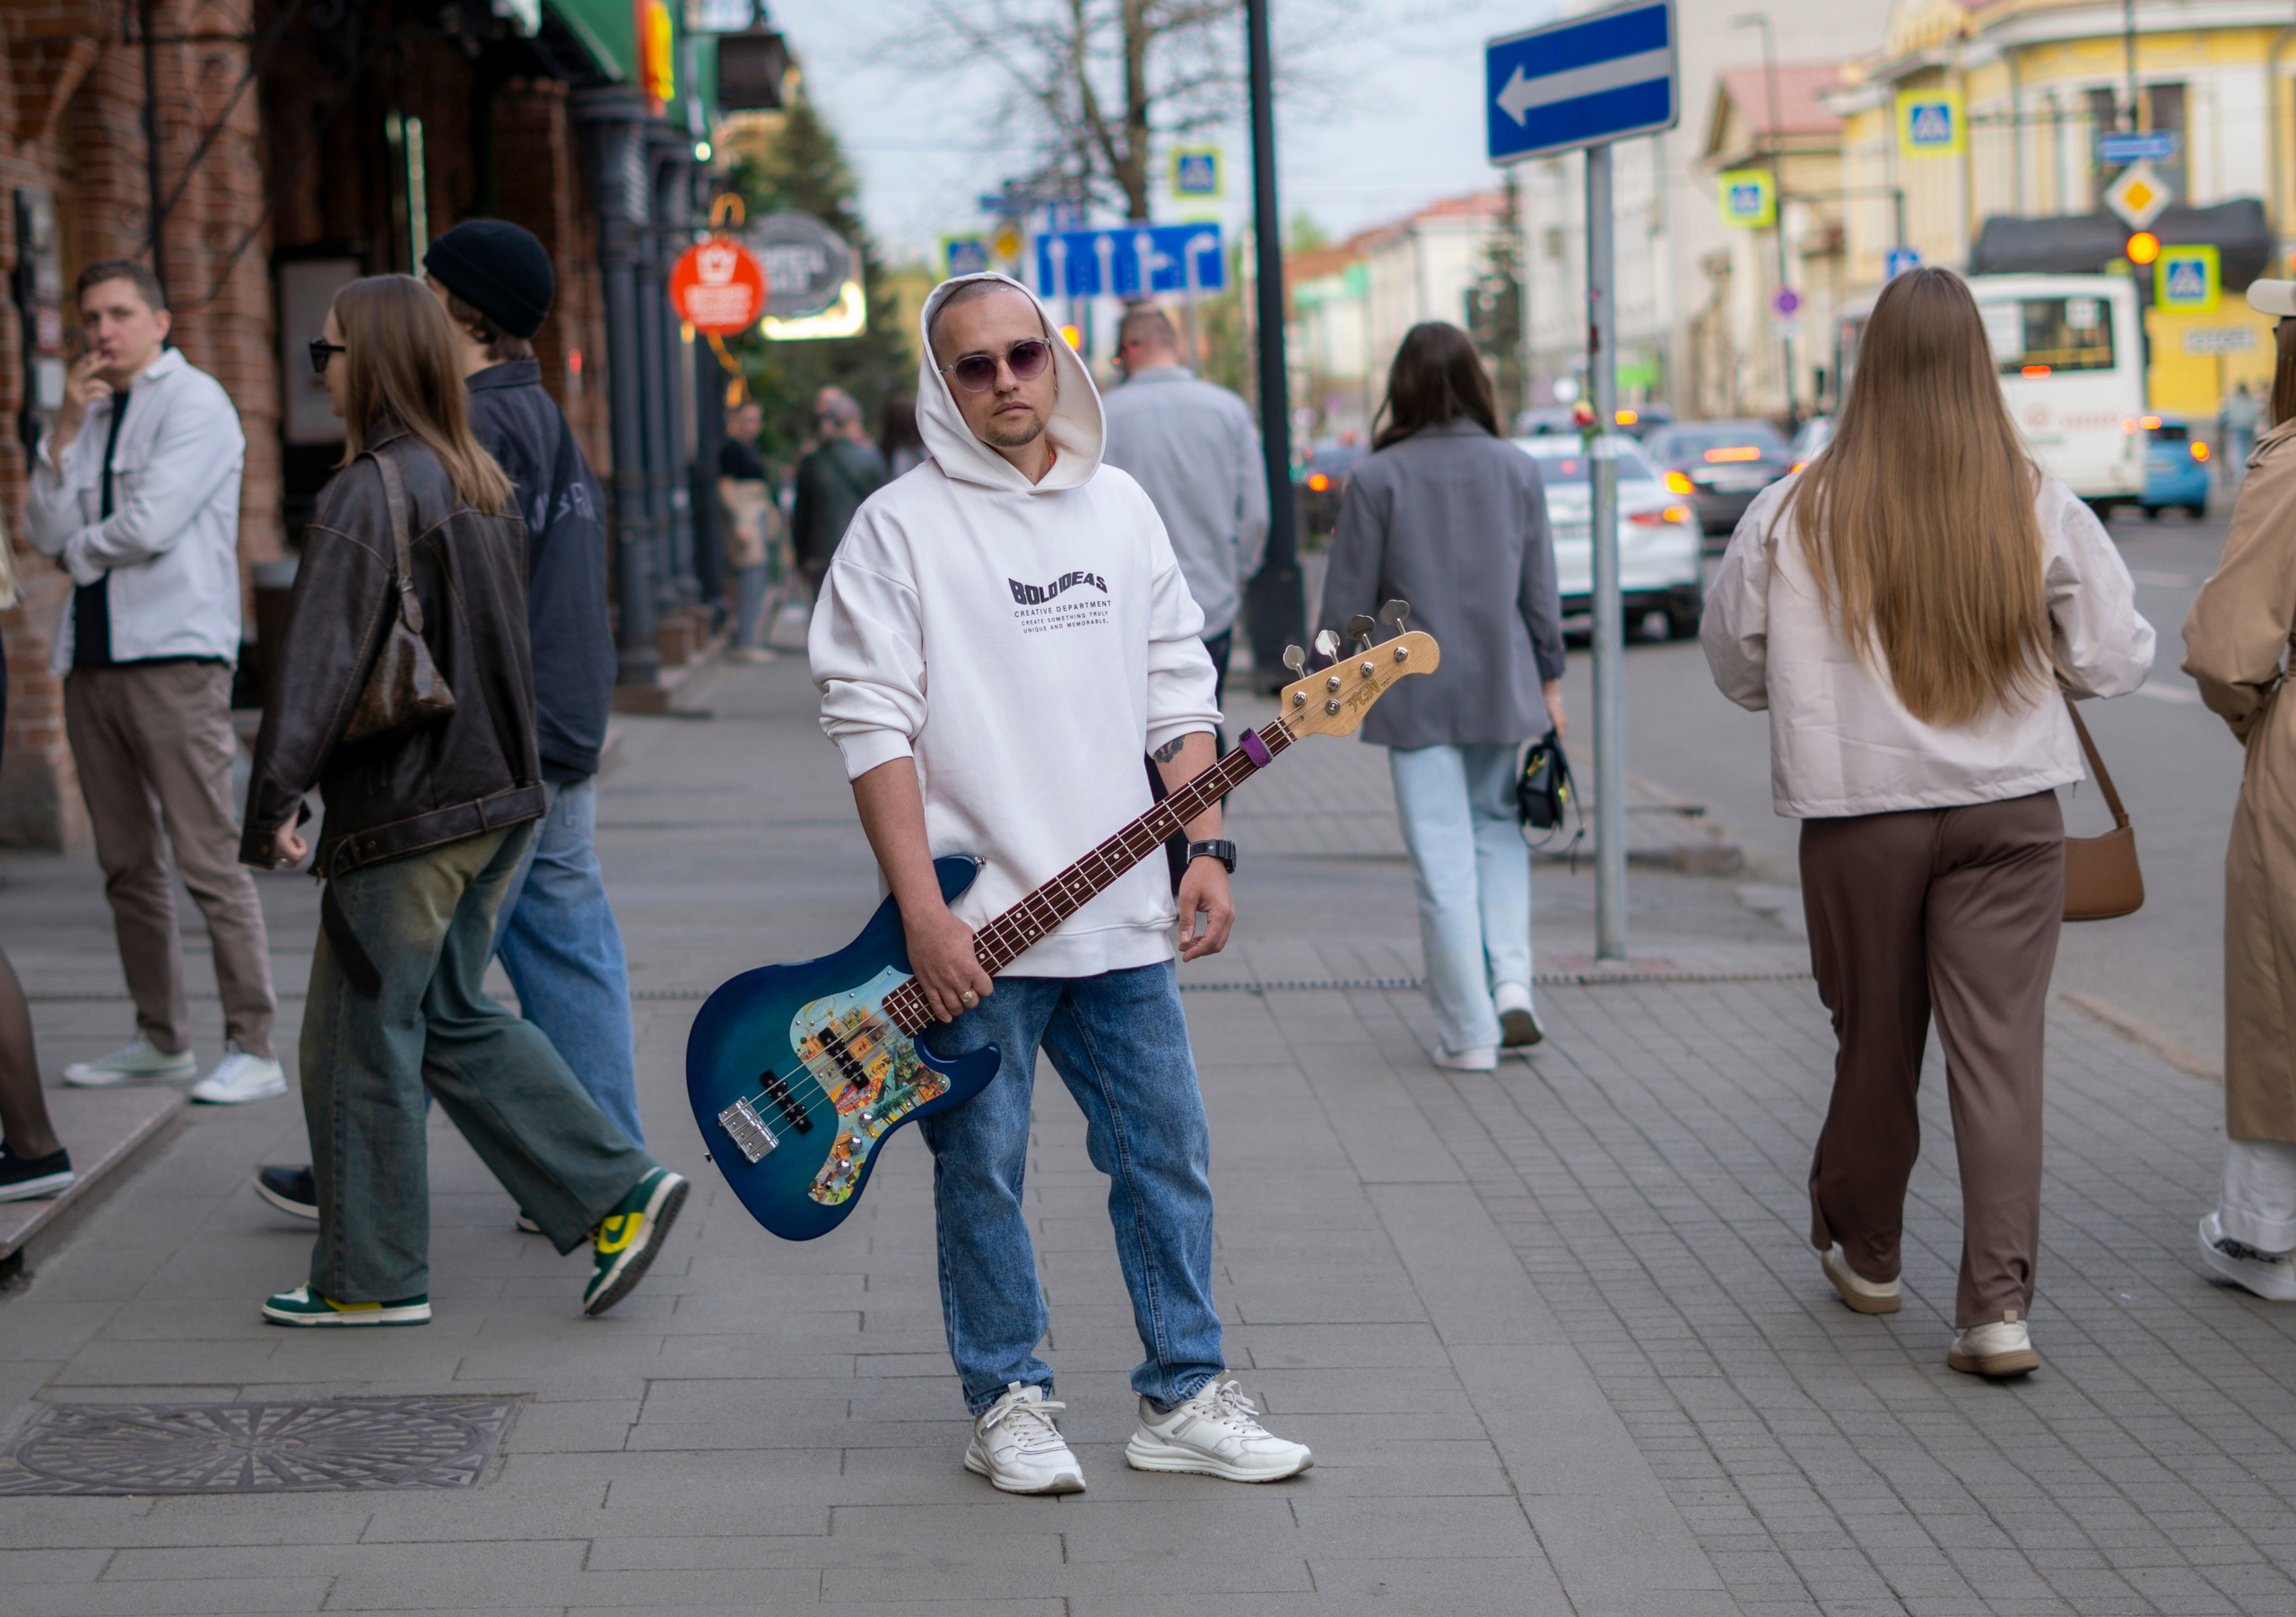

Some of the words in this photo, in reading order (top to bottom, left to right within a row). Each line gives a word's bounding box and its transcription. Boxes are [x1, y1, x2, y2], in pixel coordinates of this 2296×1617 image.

[1008, 578, 1058, 605] BOLD
[1058, 571, 1108, 594] IDEAS
[1014, 607, 1053, 618] CREATIVE
[1056, 600, 1111, 613] DEPARTMENT
[1021, 618, 1044, 626] CREATE
[1048, 613, 1086, 622] SOMETHING
[1023, 625, 1047, 634] UNIQUE
[1066, 618, 1109, 628] MEMORABLE.
